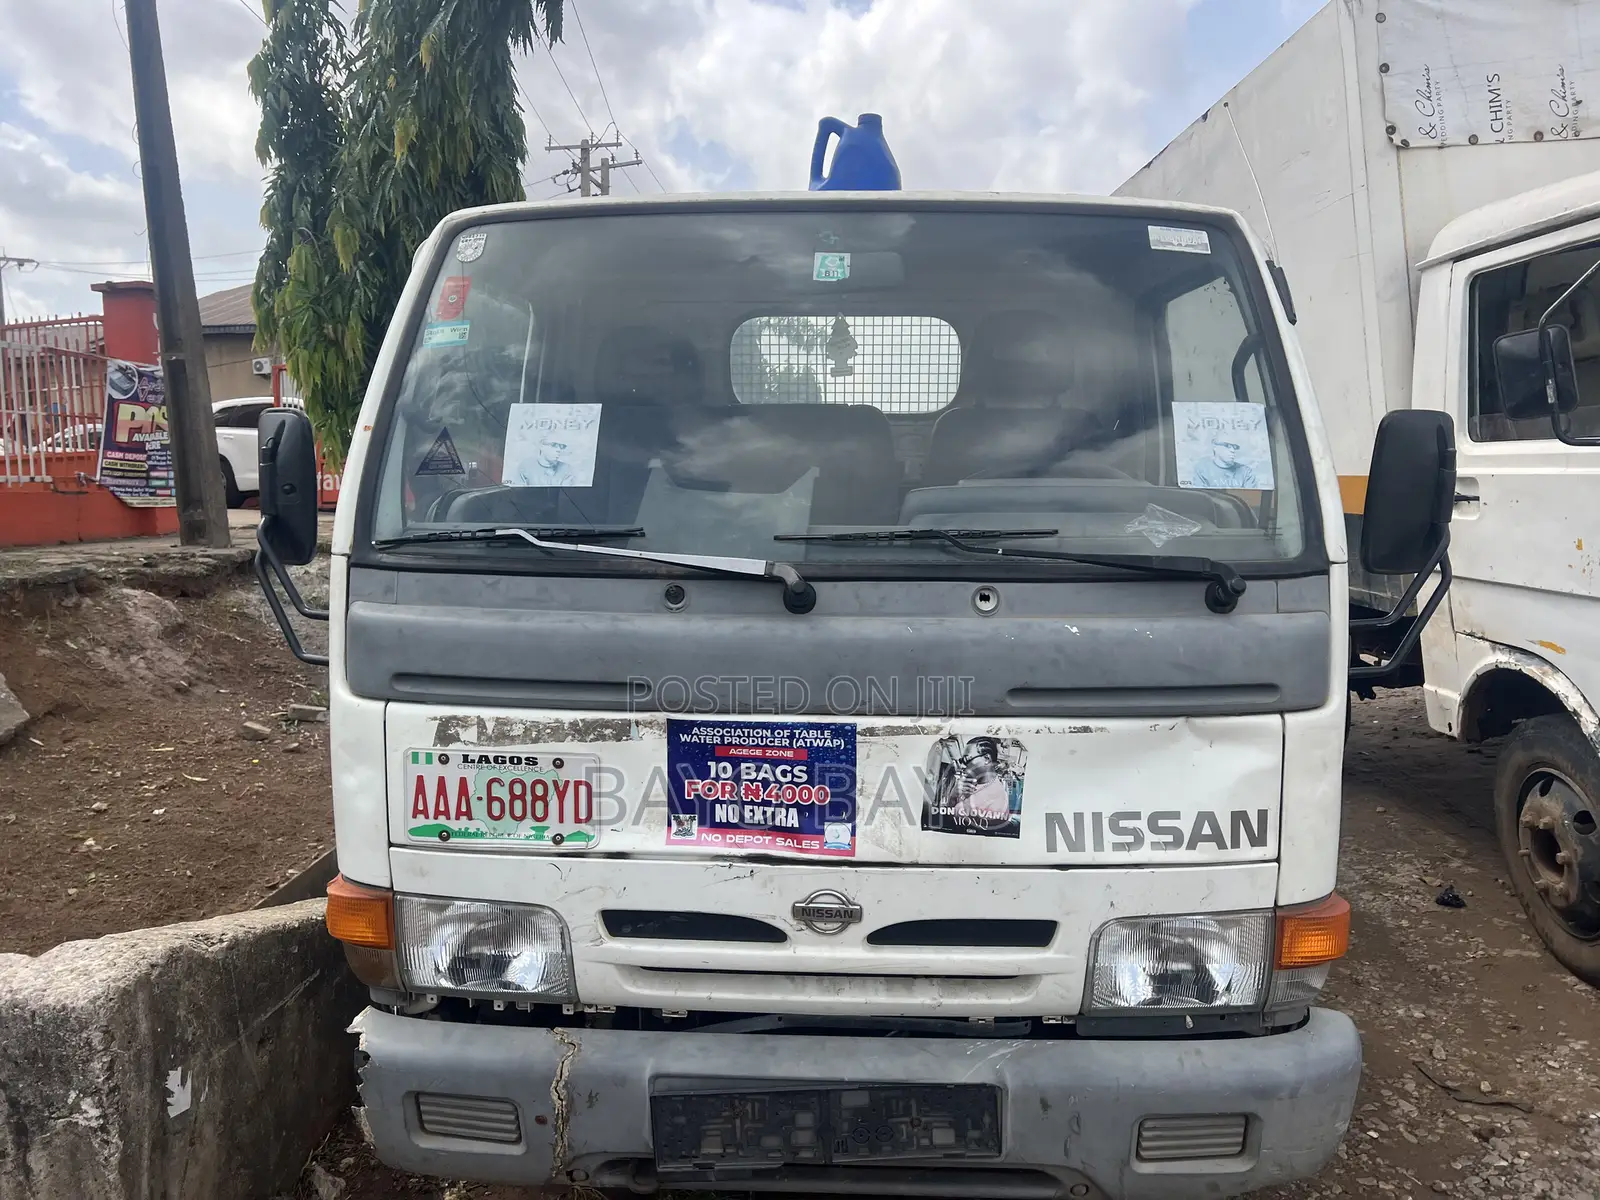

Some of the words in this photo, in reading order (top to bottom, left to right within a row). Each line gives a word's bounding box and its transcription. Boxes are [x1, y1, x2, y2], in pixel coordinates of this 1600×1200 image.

[1415, 64, 1435, 117] Chim's
[1435, 80, 1443, 107] PARTY
[1549, 64, 1570, 117] Chim's
[1486, 73, 1504, 133] CHIM'S
[1418, 122, 1437, 139] &
[1551, 123, 1568, 139] &
[679, 733, 722, 745] WATER
[724, 735, 790, 747] PRODUCER
[792, 738, 845, 750] (ATWAP)
[691, 727, 771, 738] ASSOCIATION
[773, 729, 791, 738] OF
[793, 729, 832, 739] TABLE
[461, 753, 539, 766] LAGOS
[729, 748, 763, 756] AGEGE
[765, 749, 794, 758] ZONE
[456, 763, 487, 771] CENTRE
[498, 765, 544, 773] EXCELLENCE
[707, 761, 733, 778] 10
[740, 762, 808, 783] BAGS
[685, 779, 737, 800] FOR
[715, 803, 740, 824] NO
[744, 805, 799, 828] EXTRA
[931, 806, 955, 816] DON
[1045, 808, 1269, 854] NISSAN
[700, 833, 722, 843] NO
[726, 834, 773, 845] DEPOT
[775, 837, 820, 850] SALES
[801, 907, 854, 919] NISSAN
